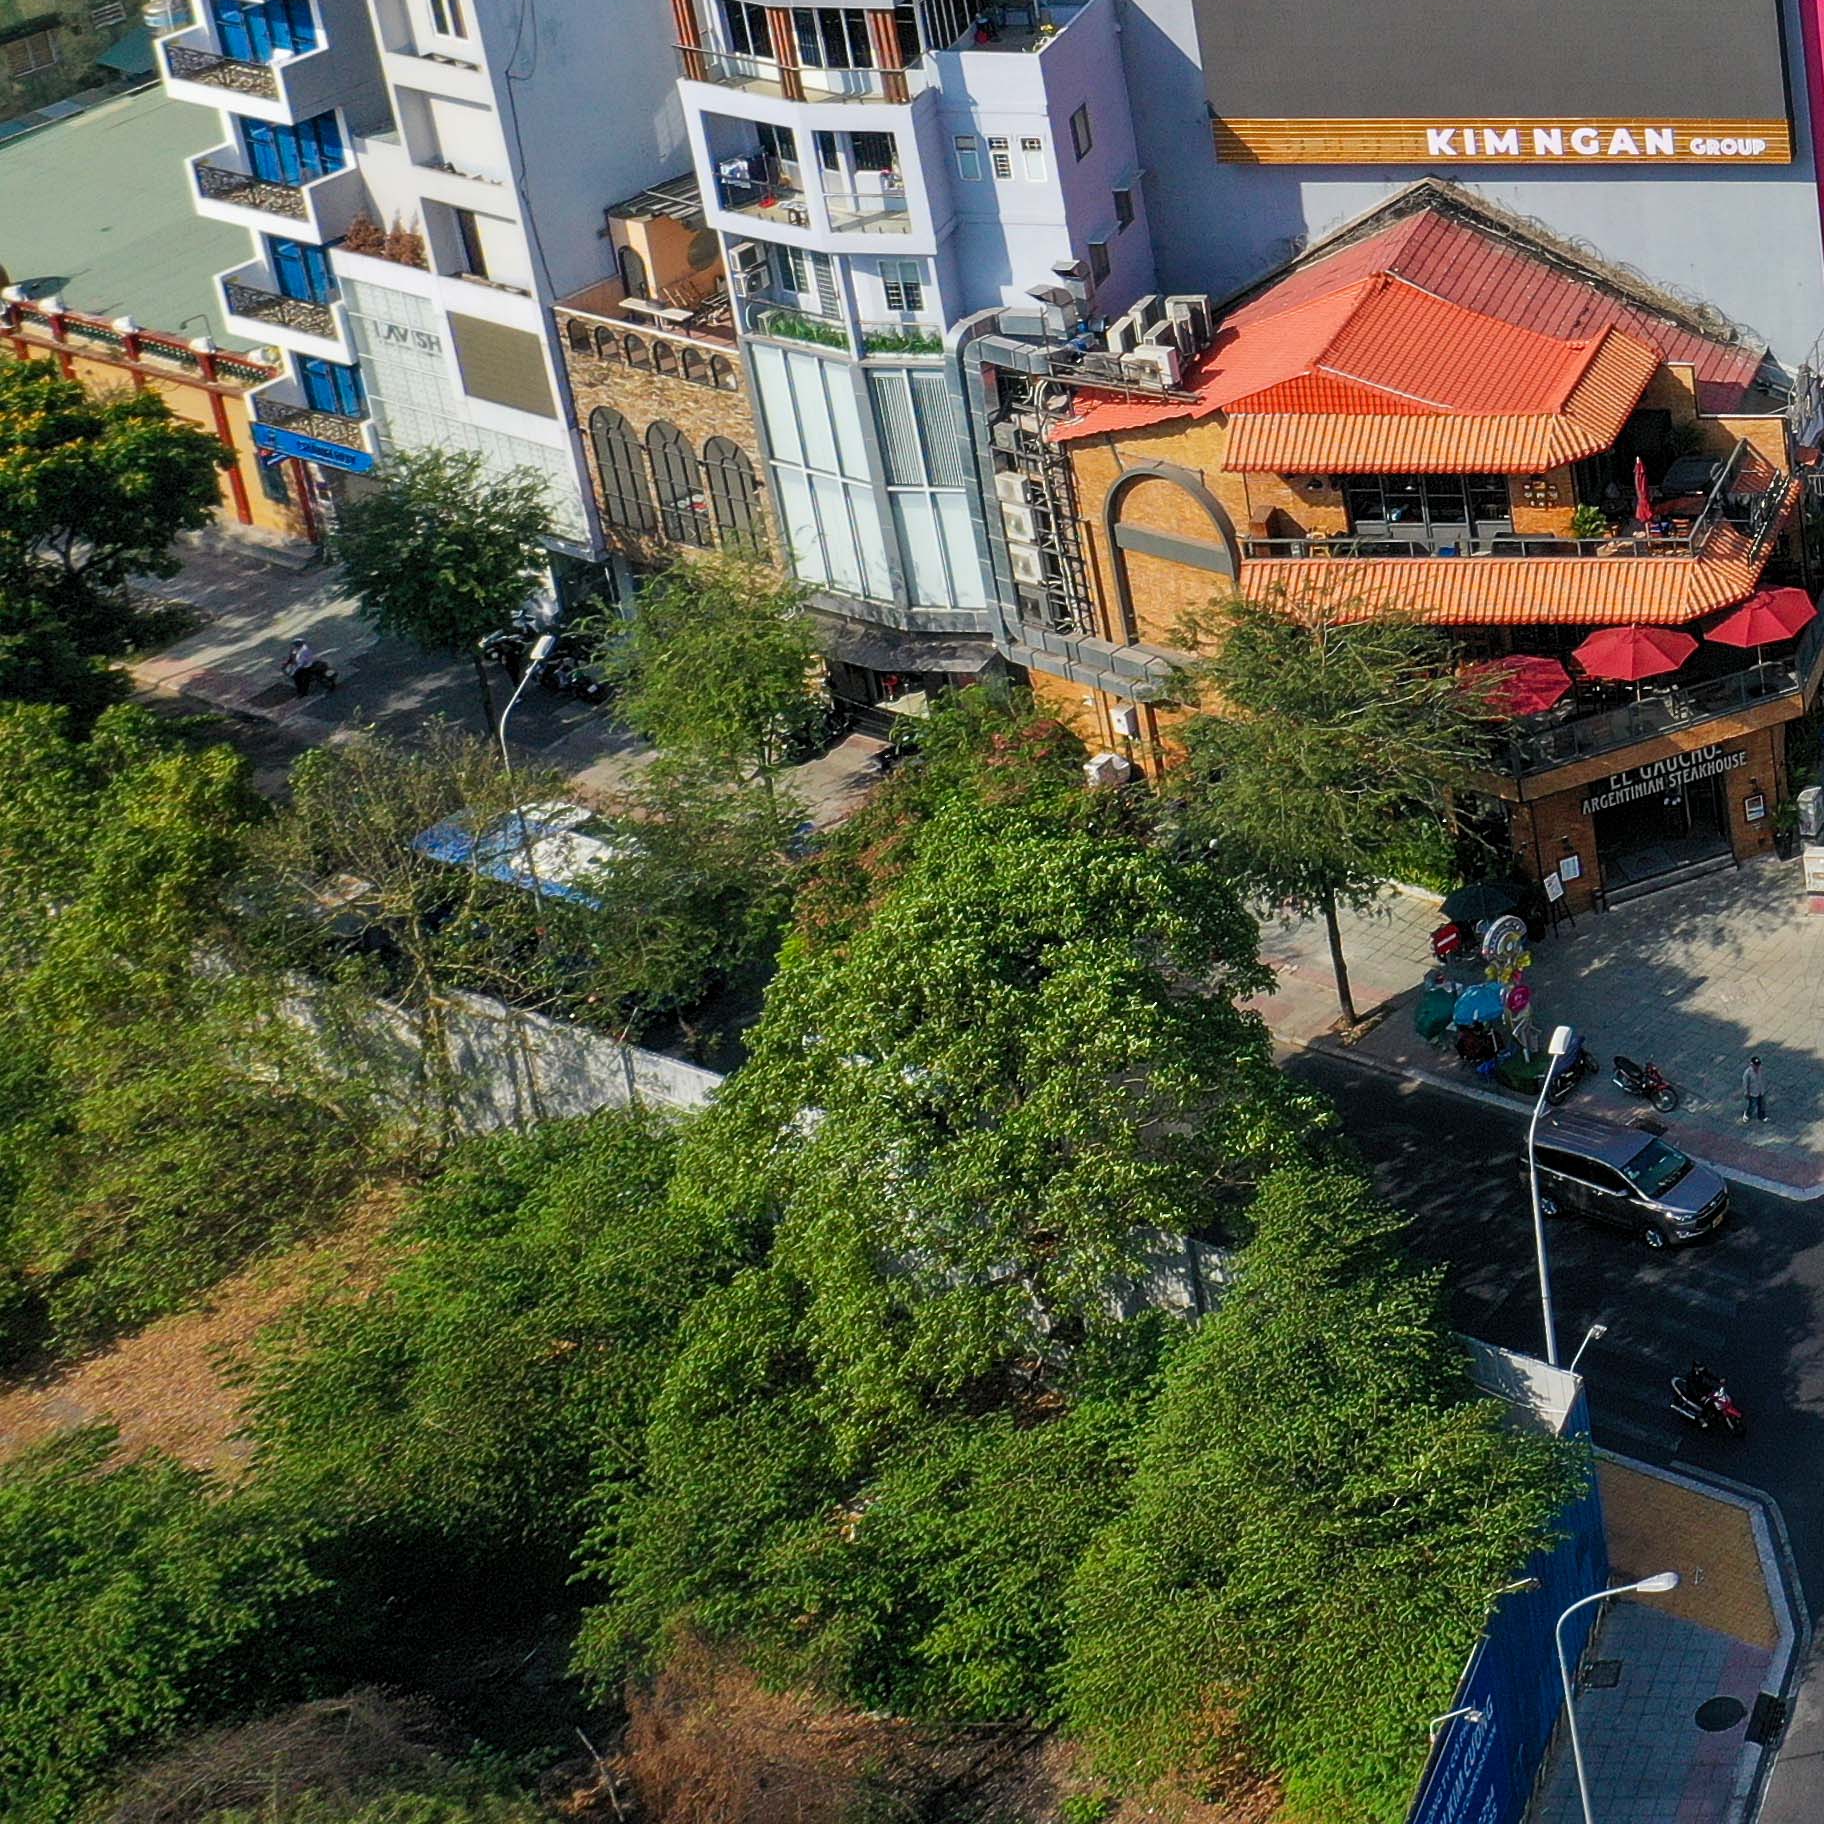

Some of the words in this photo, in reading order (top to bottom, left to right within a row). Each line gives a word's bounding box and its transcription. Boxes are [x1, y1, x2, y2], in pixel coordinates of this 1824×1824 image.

[1425, 128, 1520, 156] KIM
[1533, 128, 1674, 155] NGAN
[1690, 138, 1766, 156] GROUP
[1582, 776, 1664, 816] ARGENTINIAN
[1668, 751, 1749, 789] STEAKHOUSE
[1610, 769, 1633, 790] EL
